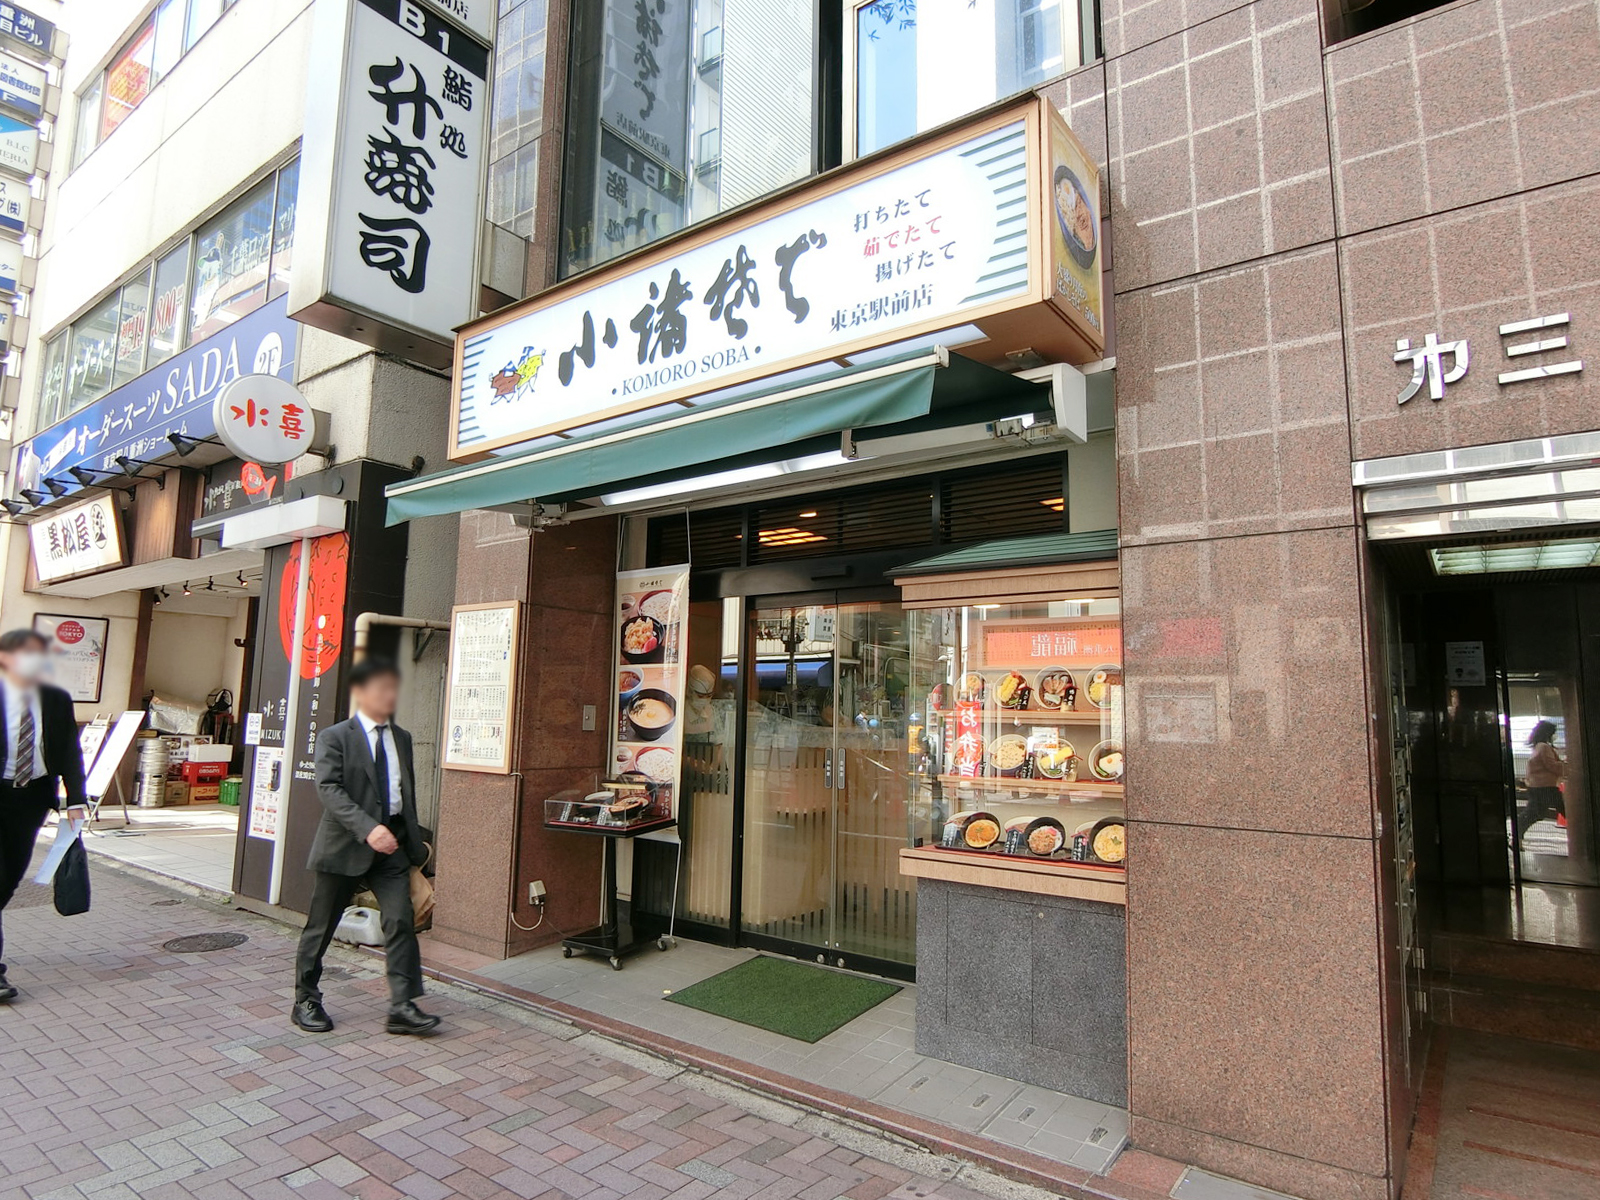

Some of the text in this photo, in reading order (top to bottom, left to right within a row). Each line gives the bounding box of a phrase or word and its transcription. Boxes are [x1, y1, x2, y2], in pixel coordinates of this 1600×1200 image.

[854, 188, 932, 233] 打ちたて
[863, 215, 943, 258] 茹でたて
[875, 241, 957, 283] 揚げたて
[558, 228, 827, 387] 小諸そば
[829, 283, 934, 334] 東京駅前店
[621, 345, 750, 397] KOMORO SOBA
[77, 390, 161, 456] オーダースーツ
[162, 337, 242, 416] SADA
[229, 398, 306, 440] 水喜
[47, 512, 92, 561] 黒松屋
[263, 697, 286, 721] 水喜
